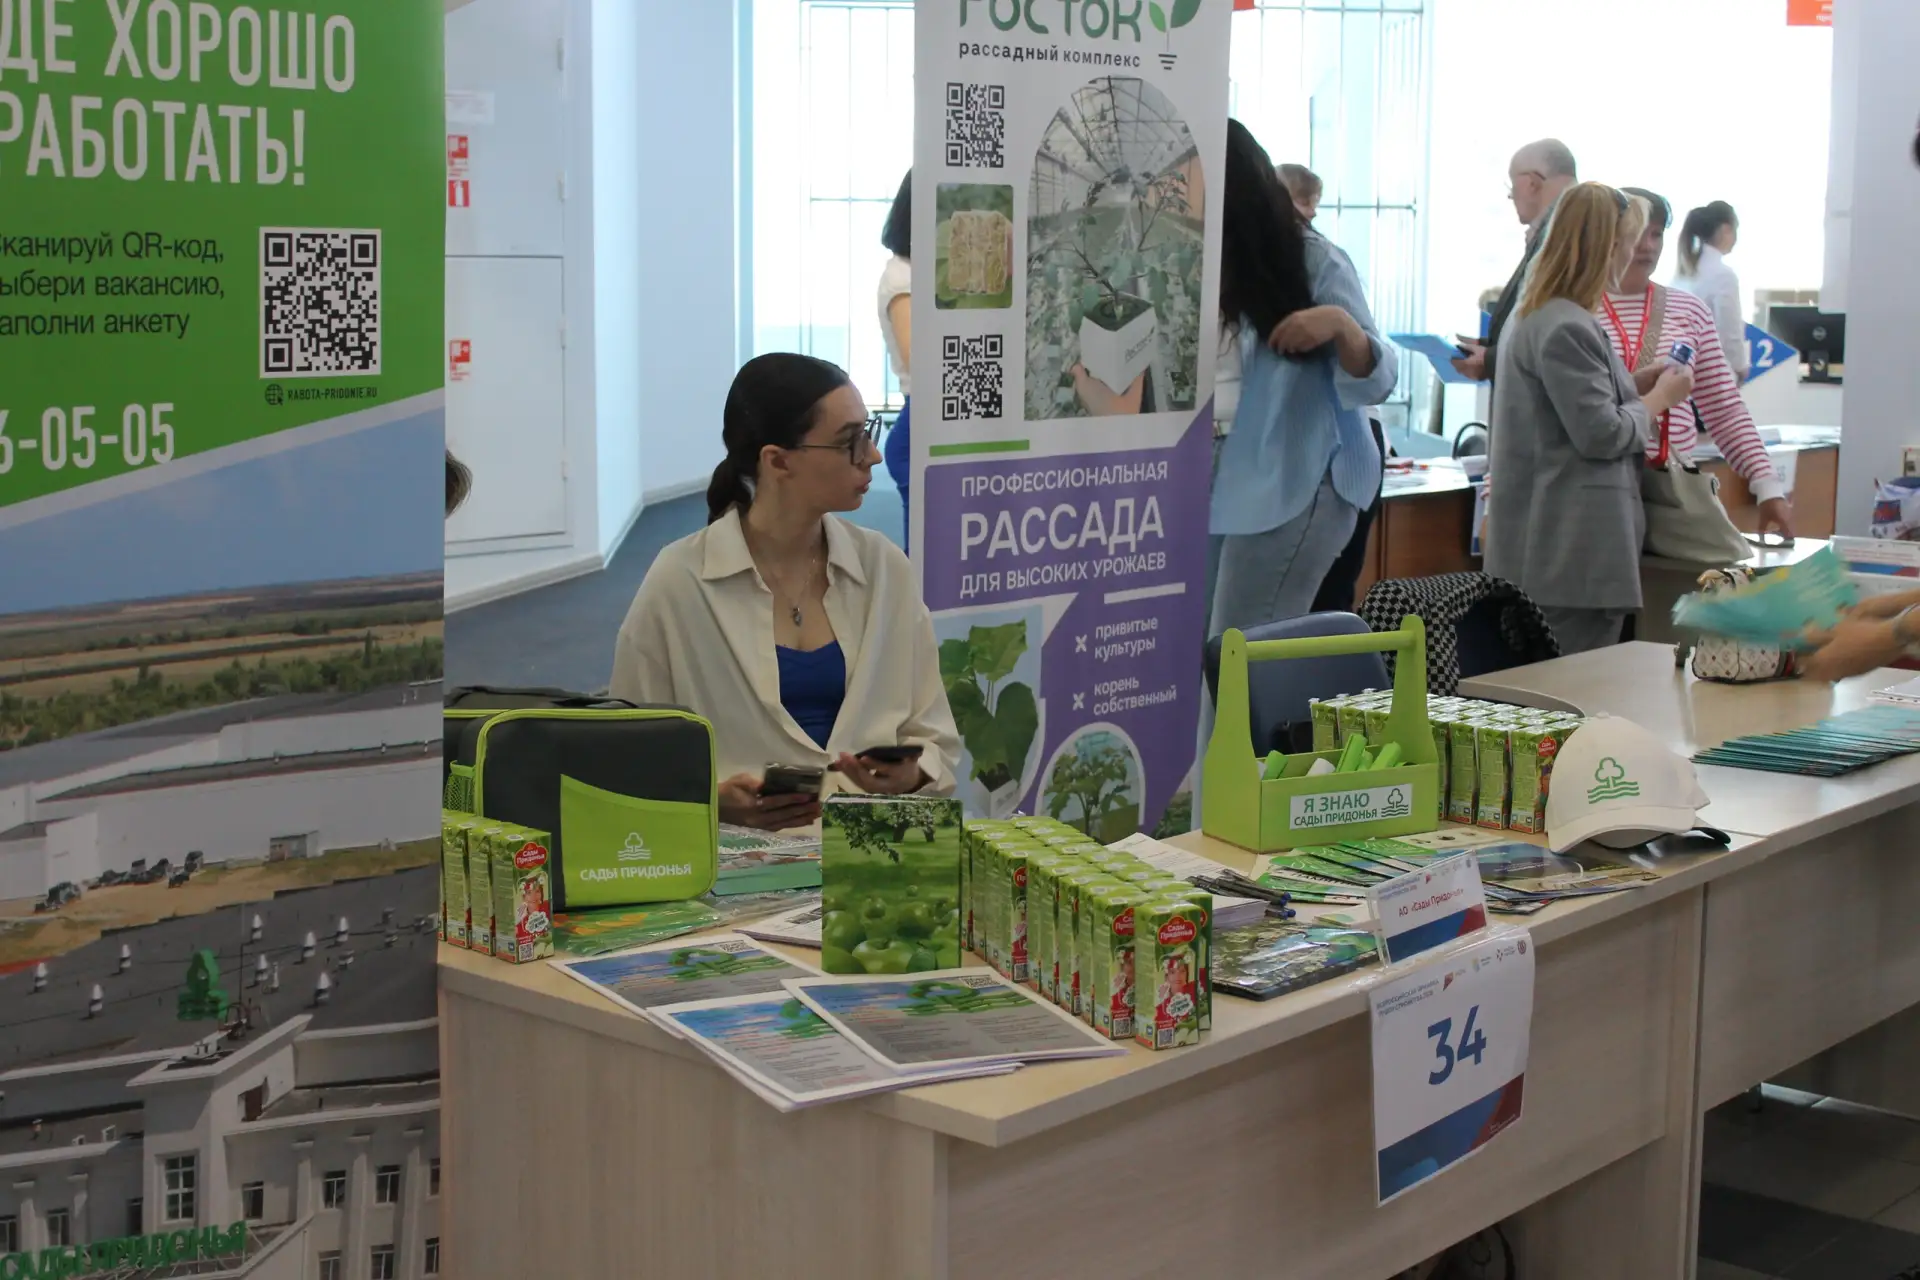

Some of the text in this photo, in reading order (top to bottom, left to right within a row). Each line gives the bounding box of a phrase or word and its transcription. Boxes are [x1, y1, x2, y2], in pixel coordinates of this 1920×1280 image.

[104, 0, 355, 93] ХОРОШО
[959, 42, 1141, 67] рассадный комплекс
[0, 231, 224, 264] канируй QR-код,
[95, 274, 224, 299] вакансию,
[104, 312, 190, 339] анкету
[961, 460, 1168, 498] ПРОФЕССИОНАЛЬНАЯ
[960, 496, 1165, 561] РАССАДА
[960, 552, 1166, 599] ДЛЯ ВЫСОКИХ УРОЖАЕВ
[1095, 617, 1158, 641] привитые
[1094, 636, 1156, 662] культуры
[1094, 676, 1139, 697] корень
[1093, 684, 1177, 716] собственный
[1303, 793, 1370, 814] Я ЗНАЮ
[1294, 808, 1378, 827] САДЫ ПРИДОНЬЯ
[580, 863, 692, 882] САДЫ ПРИДОНЬЯ
[1398, 906, 1409, 918] АО
[1428, 1004, 1487, 1086] 34
